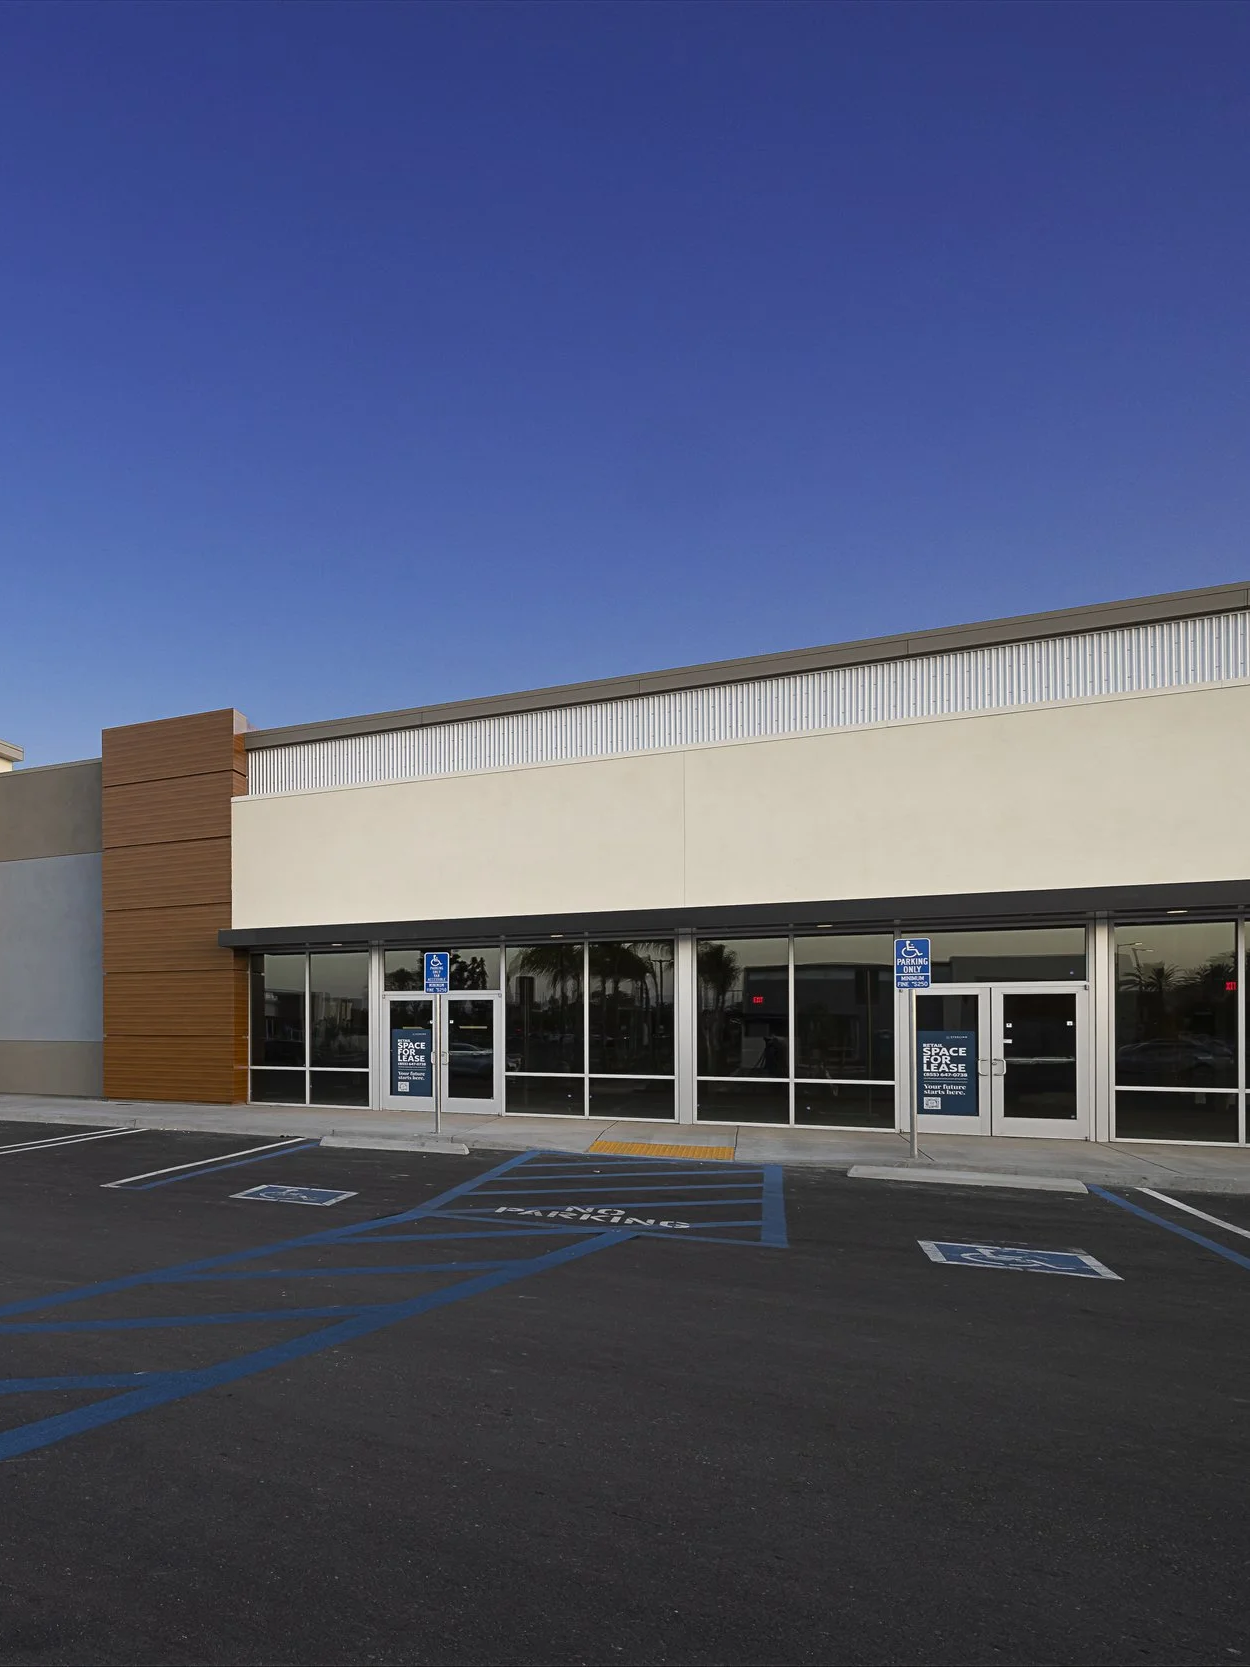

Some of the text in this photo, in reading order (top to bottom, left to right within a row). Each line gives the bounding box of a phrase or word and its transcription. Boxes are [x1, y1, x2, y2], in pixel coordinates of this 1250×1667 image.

[897, 958, 929, 966] PARKING
[903, 966, 923, 974] ONLY
[397, 1048, 416, 1056] FOR
[923, 1047, 967, 1056] SPACE
[923, 1055, 951, 1064] FOR
[923, 1063, 966, 1072] LEASE
[565, 1206, 625, 1216] NO
[494, 1206, 691, 1229] PARKING
